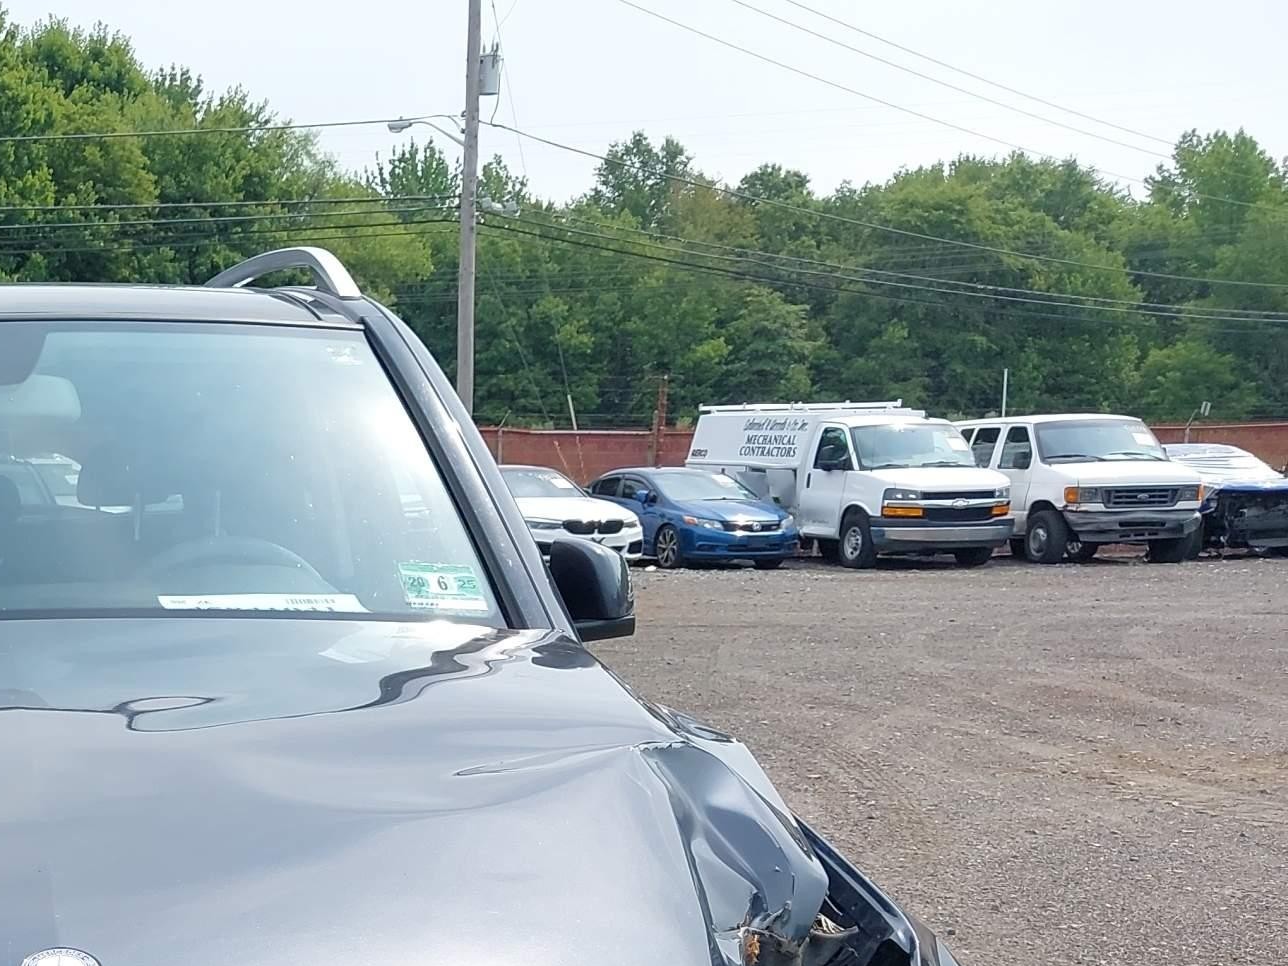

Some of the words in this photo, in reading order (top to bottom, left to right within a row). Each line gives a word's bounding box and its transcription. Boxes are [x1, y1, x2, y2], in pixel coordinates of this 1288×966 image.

[745, 434, 796, 445] MECHANICAL
[739, 446, 797, 457] CONTRACTORS
[407, 576, 426, 588] 20
[437, 575, 449, 591] 6
[457, 579, 477, 590] 25
